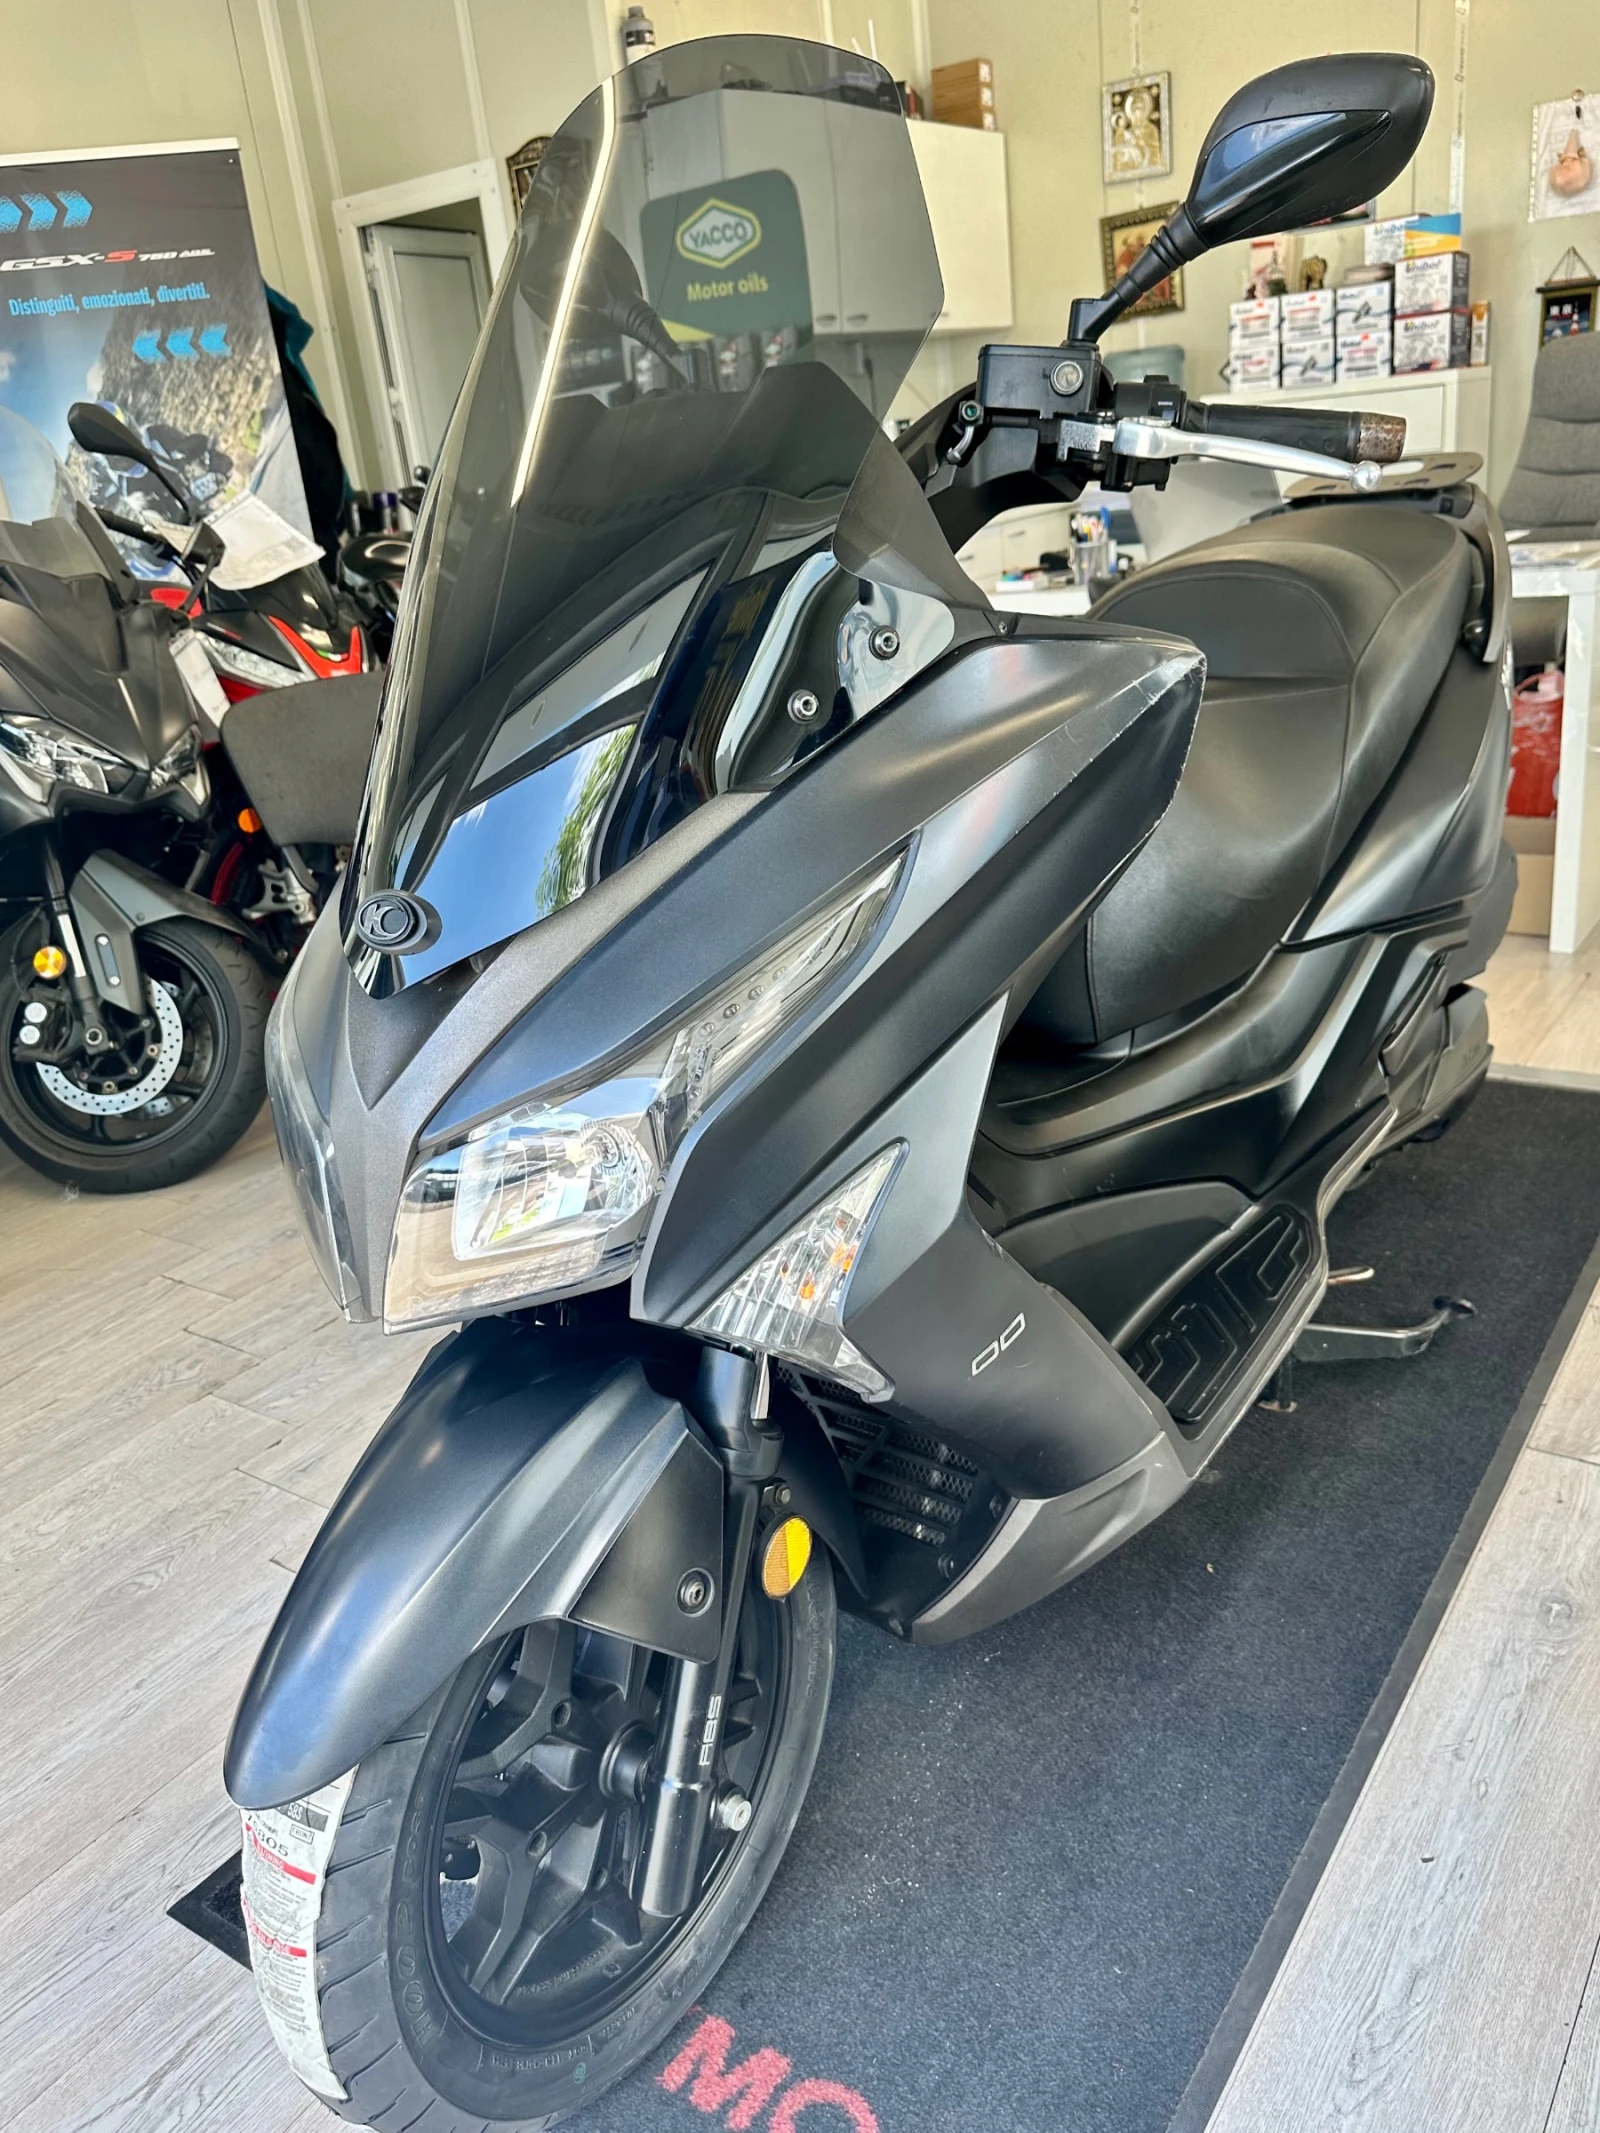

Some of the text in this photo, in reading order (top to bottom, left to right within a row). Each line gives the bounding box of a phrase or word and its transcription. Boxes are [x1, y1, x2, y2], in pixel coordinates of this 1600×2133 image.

[689, 221, 748, 249] YACCO
[0, 249, 138, 272] GSX-S
[8, 281, 211, 317] Distinguiti, emozionati, divertiti.
[686, 271, 769, 303] Motor oils
[699, 1695, 722, 1767] ABS
[287, 1802, 304, 1820] 58S
[291, 1825, 315, 1842] FRONT
